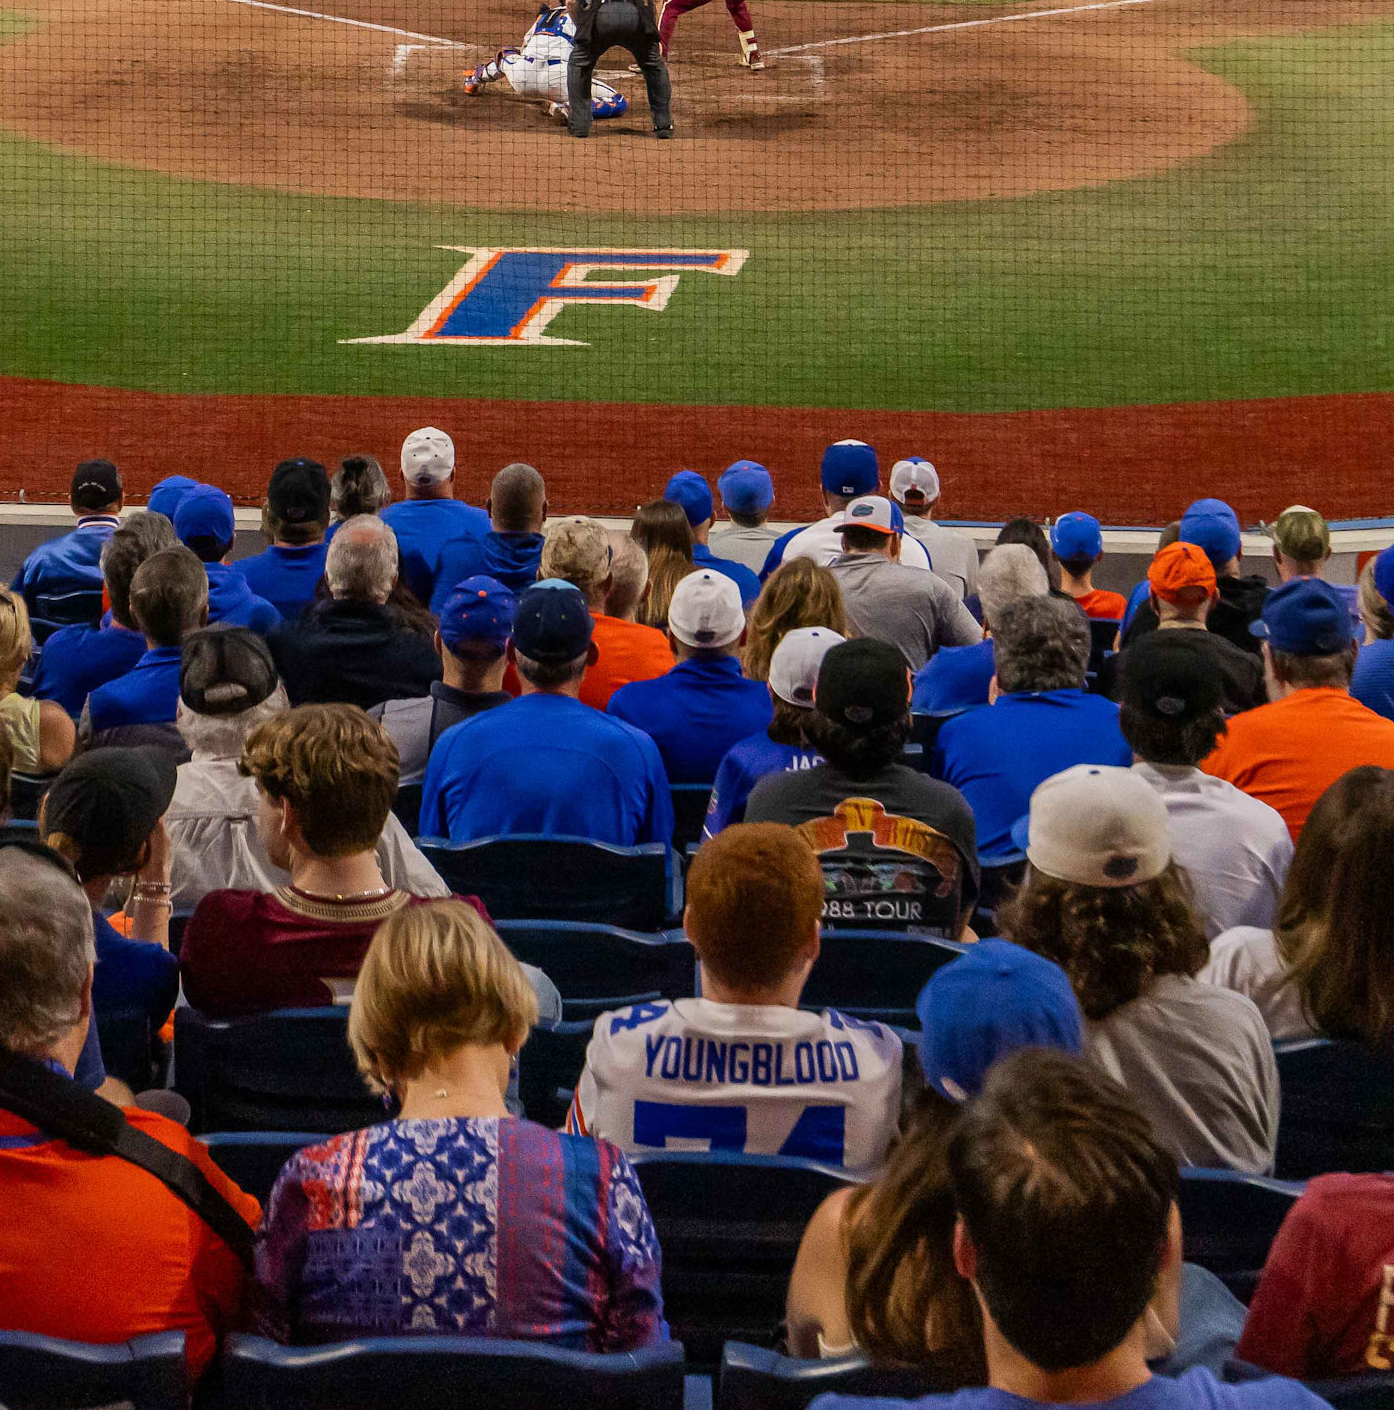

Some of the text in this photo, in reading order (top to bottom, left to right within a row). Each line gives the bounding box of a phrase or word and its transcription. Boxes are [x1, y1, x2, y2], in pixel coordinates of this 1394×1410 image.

[338, 245, 751, 347] F
[863, 900, 923, 919] TOUR
[645, 1033, 860, 1085] YOUNGBLOOD
